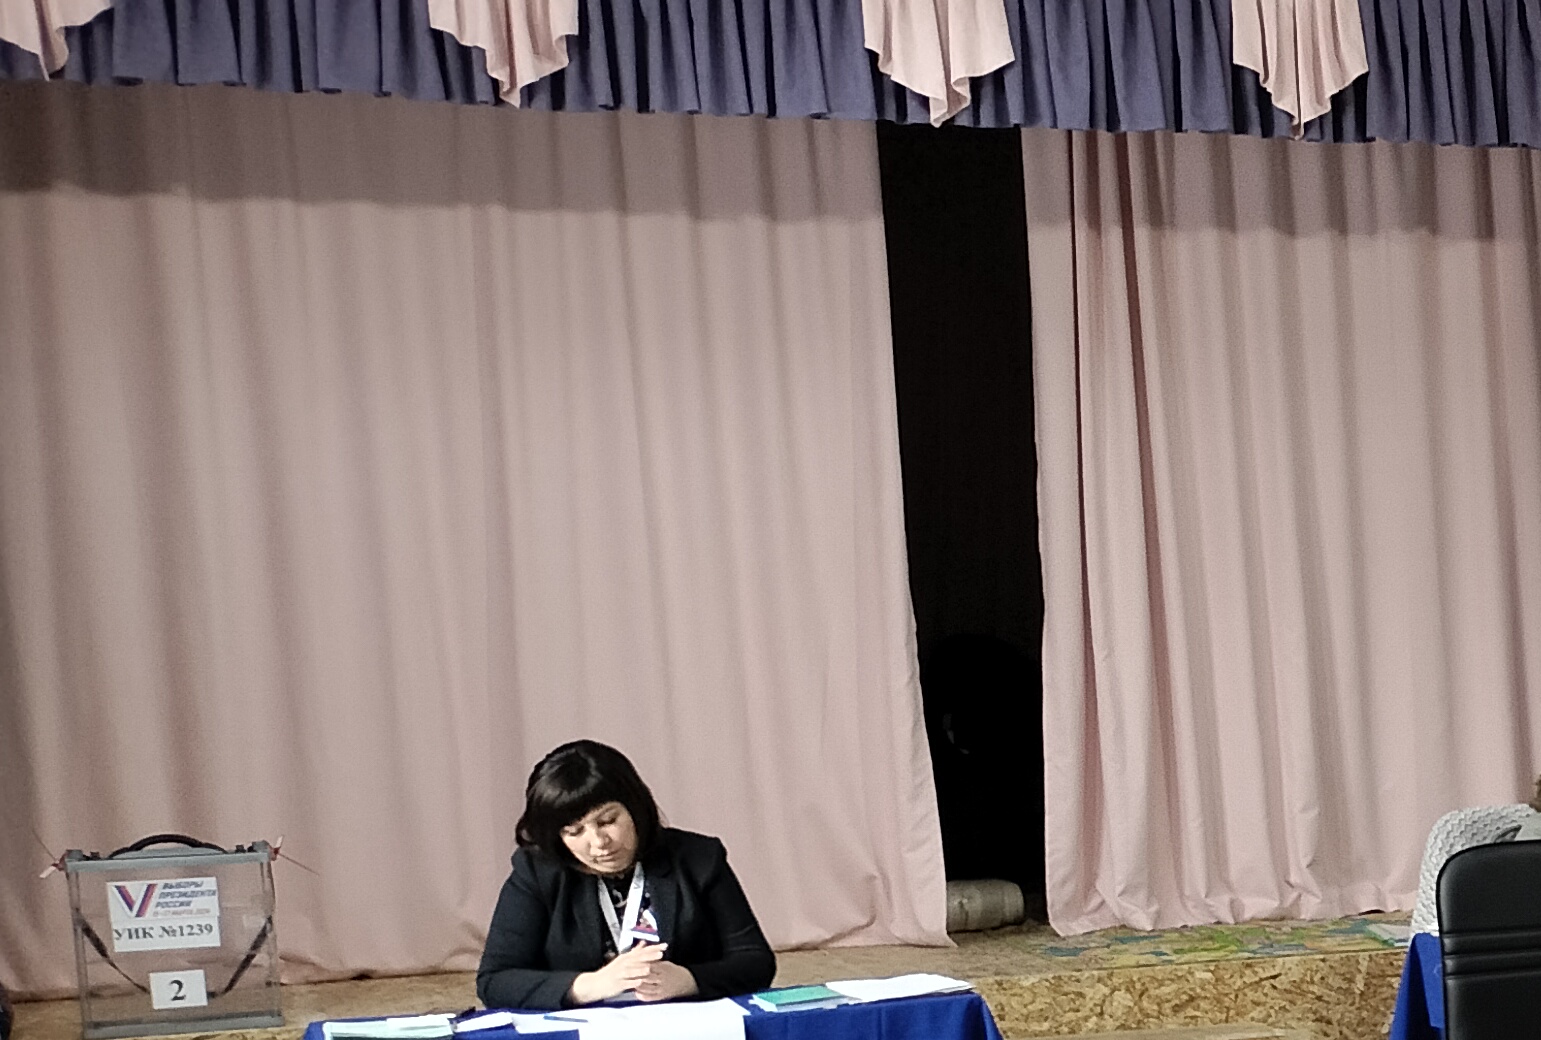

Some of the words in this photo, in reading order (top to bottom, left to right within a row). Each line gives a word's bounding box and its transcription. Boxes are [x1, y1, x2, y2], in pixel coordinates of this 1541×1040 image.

[114, 927, 154, 940] УИК
[159, 923, 213, 939] №1239
[169, 980, 186, 1001] 2
